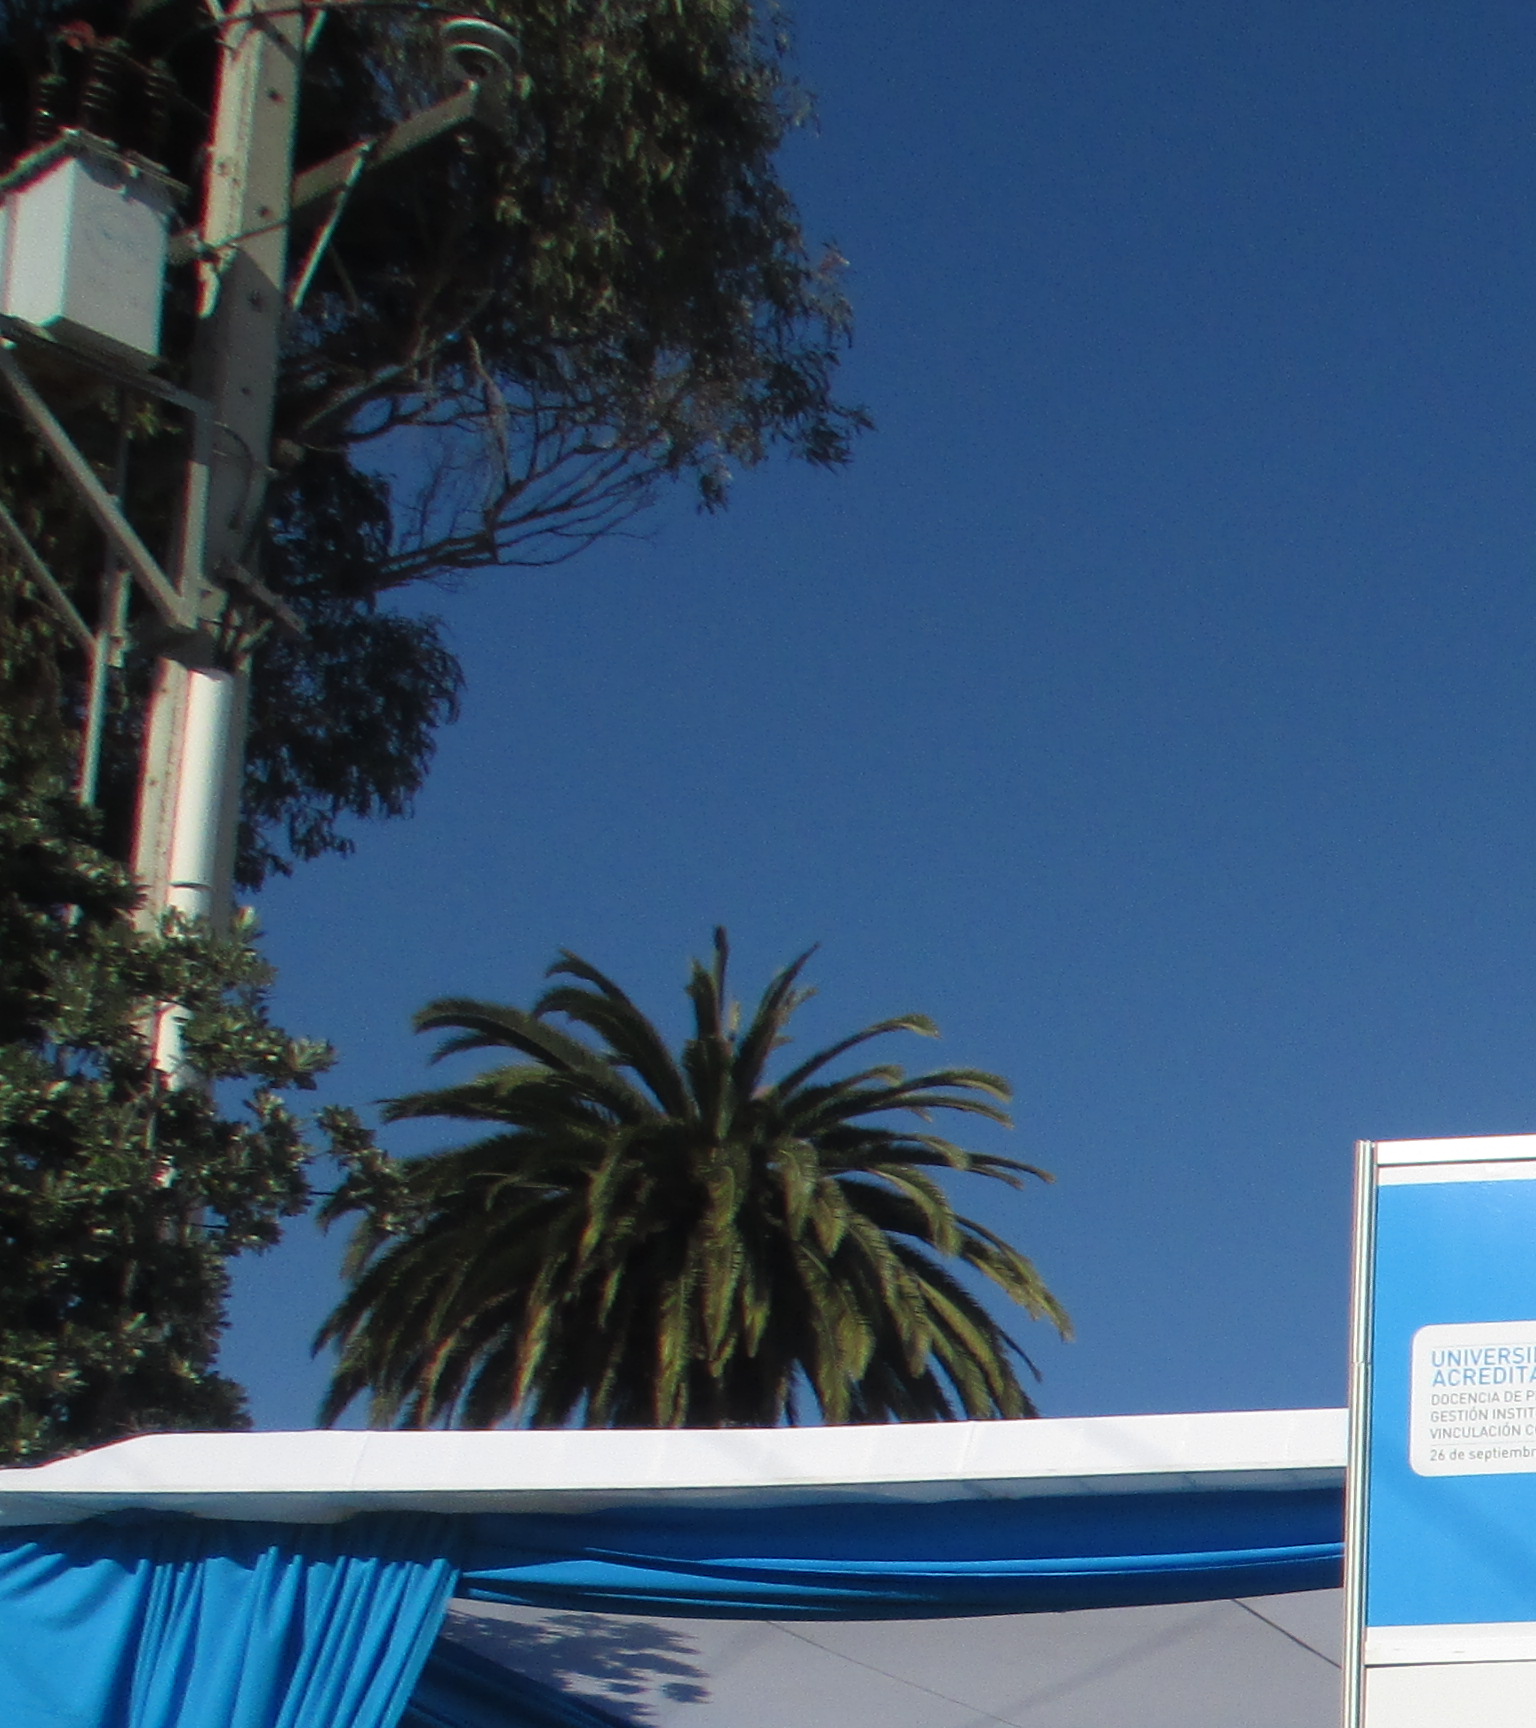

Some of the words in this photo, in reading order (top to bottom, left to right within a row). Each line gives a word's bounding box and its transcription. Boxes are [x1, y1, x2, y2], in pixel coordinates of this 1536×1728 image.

[1431, 1391, 1500, 1406] DOCENCIA
[1504, 1390, 1523, 1403] DE
[1430, 1406, 1488, 1422] GESTIÓN
[1430, 1422, 1521, 1439] VINCULACIÓN
[1430, 1449, 1445, 1461] 26
[1449, 1448, 1465, 1460] de
